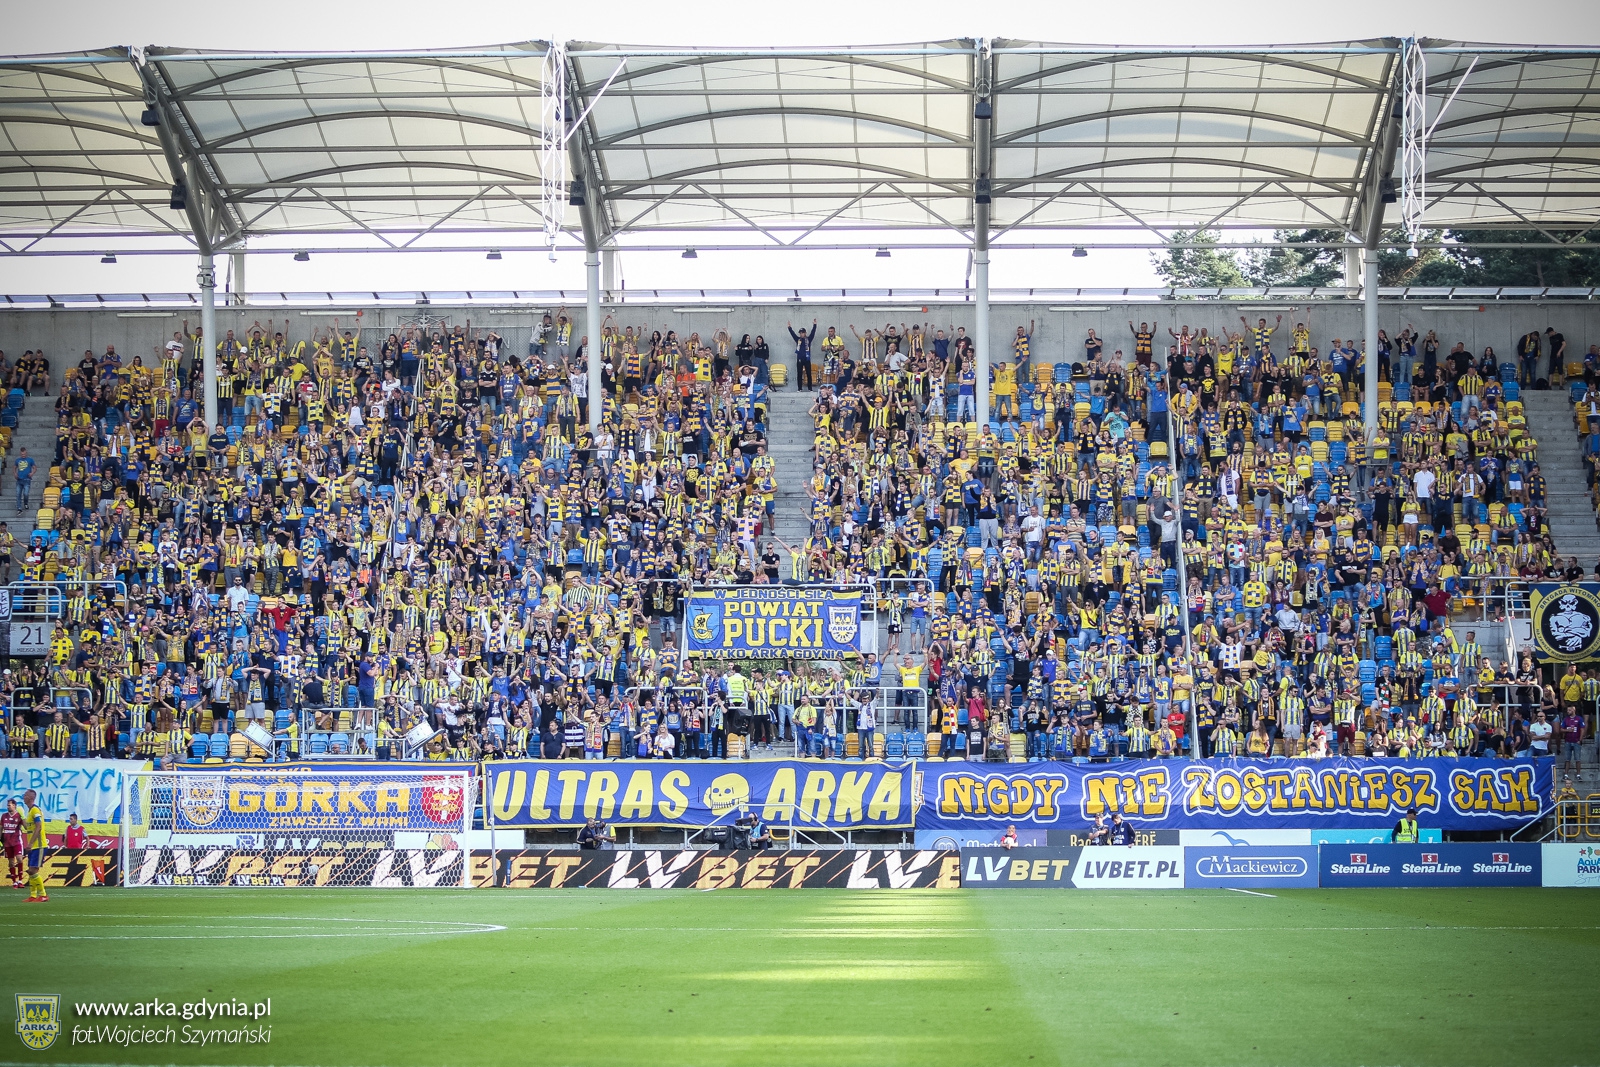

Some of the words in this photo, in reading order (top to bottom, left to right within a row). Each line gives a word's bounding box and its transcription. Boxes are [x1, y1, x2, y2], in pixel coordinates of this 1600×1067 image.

[714, 588, 727, 599] W
[731, 586, 800, 599] JEDNOŚCI
[804, 588, 834, 600] SIŁA
[1539, 588, 1568, 610] BRYGADA
[722, 601, 824, 617] POWIAT
[20, 625, 45, 645] 21
[722, 618, 824, 648] PUCKI
[701, 649, 746, 659] TYLKO
[750, 648, 789, 659] ARKA
[793, 649, 845, 659] GDYNIA
[493, 769, 691, 821] ULTRAS
[761, 767, 904, 824] ARKA
[1453, 771, 1540, 813] SAM
[1083, 860, 1180, 879] LVBET.PL
[1208, 855, 1298, 874] Mackiewicz
